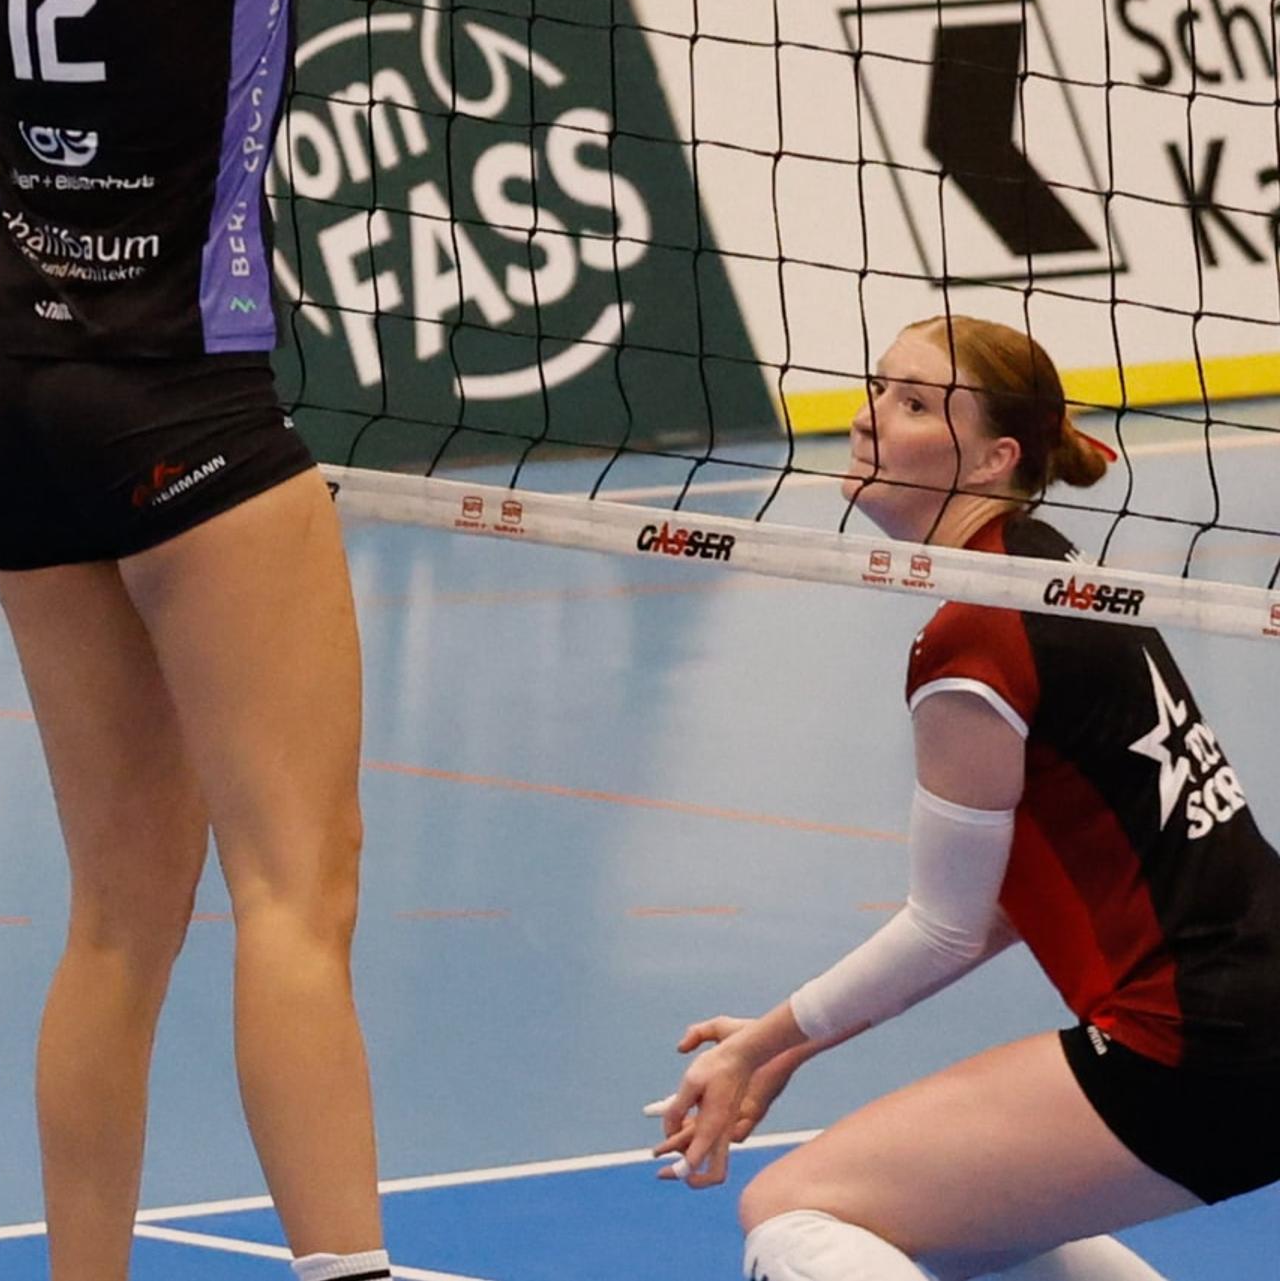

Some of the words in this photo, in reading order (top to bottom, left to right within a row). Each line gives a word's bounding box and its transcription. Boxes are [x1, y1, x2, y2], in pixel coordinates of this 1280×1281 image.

[269, 66, 429, 201] om
[318, 106, 652, 388] FASS
[637, 522, 736, 561] GASSER
[1043, 576, 1146, 617] GASSER
